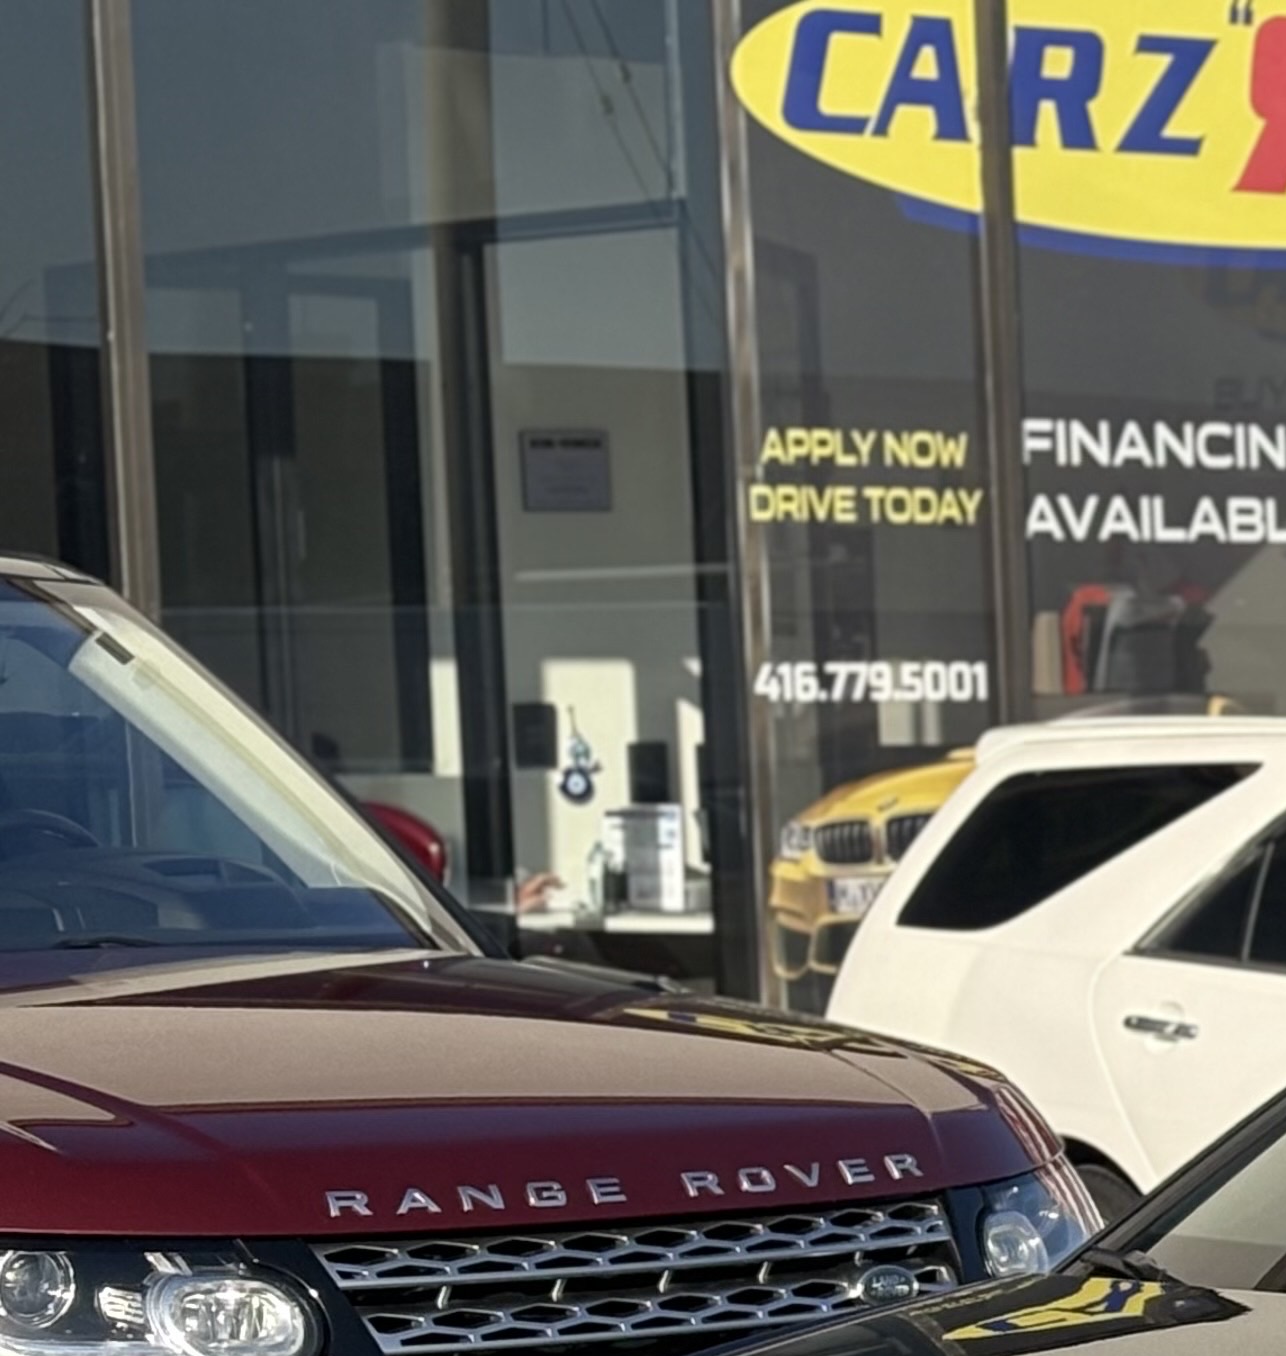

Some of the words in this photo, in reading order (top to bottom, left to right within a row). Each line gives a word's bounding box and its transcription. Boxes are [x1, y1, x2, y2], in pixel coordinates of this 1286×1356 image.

[781, 9, 1218, 157] CARZ
[760, 426, 877, 468] APPLY
[883, 430, 968, 470] NOW
[749, 485, 858, 523] DRIVE
[863, 487, 983, 526] TODAY
[753, 660, 989, 703] 416.779.5001
[324, 1176, 628, 1219] RANGE
[681, 1152, 925, 1199] ROVER
